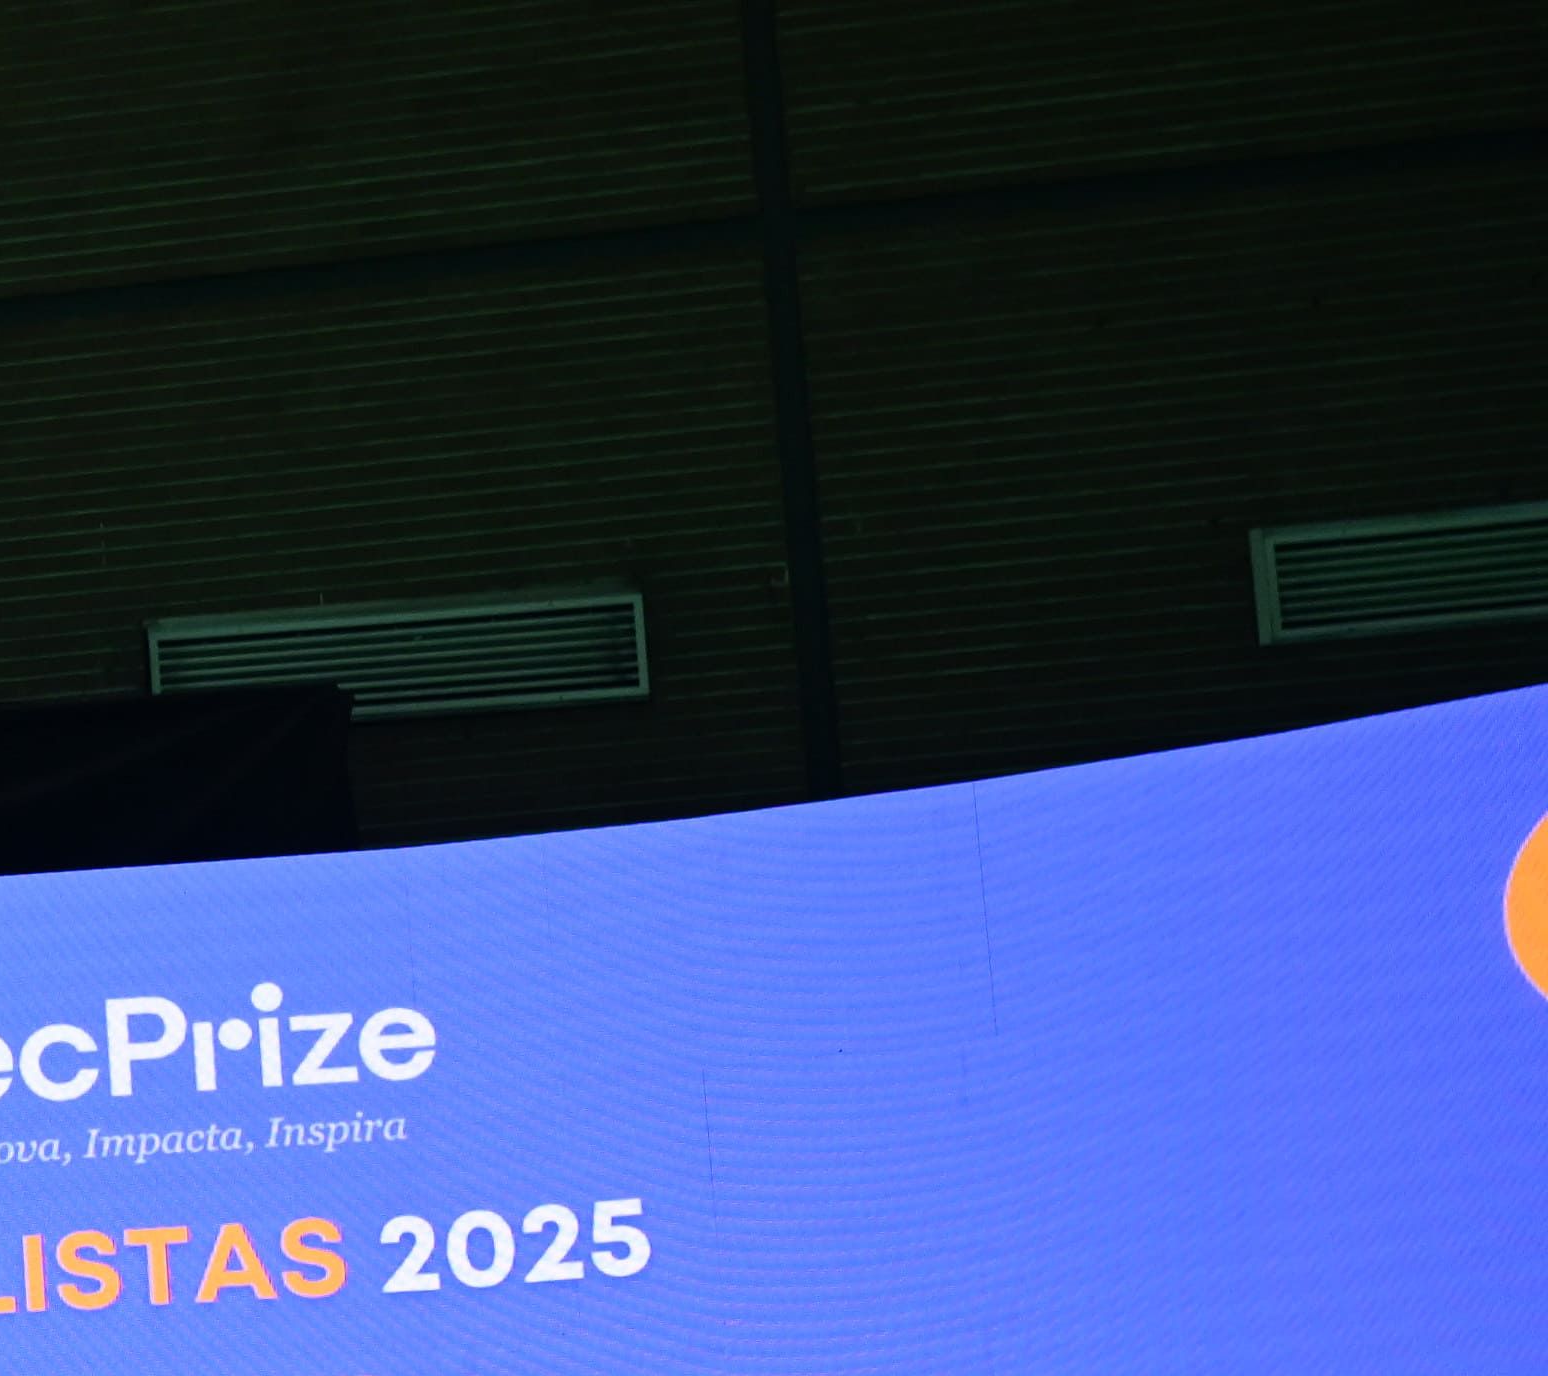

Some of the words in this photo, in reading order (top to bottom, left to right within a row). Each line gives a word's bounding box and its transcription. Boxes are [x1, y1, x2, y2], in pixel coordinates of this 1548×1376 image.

[82, 1122, 258, 1165] Impacta,
[265, 1112, 408, 1158] Inspira
[376, 1197, 654, 1296] 2025
